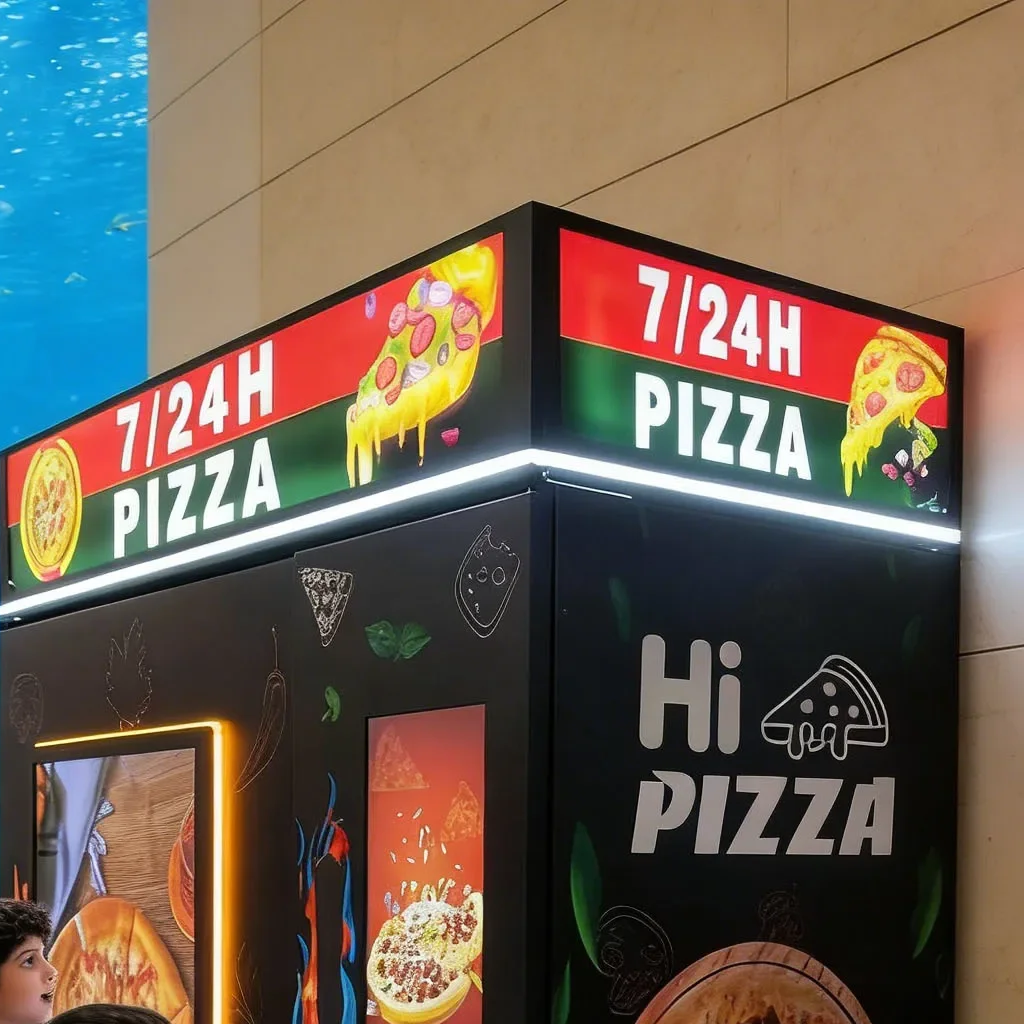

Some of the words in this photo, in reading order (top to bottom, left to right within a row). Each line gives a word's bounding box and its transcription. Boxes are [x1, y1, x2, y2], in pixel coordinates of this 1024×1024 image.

[638, 264, 802, 377] 7/24H
[116, 340, 274, 472] 7/24H
[634, 373, 812, 481] PIZZA
[113, 437, 281, 559] PIZZA
[639, 634, 742, 754] Hi
[631, 770, 896, 855] PIZZA
